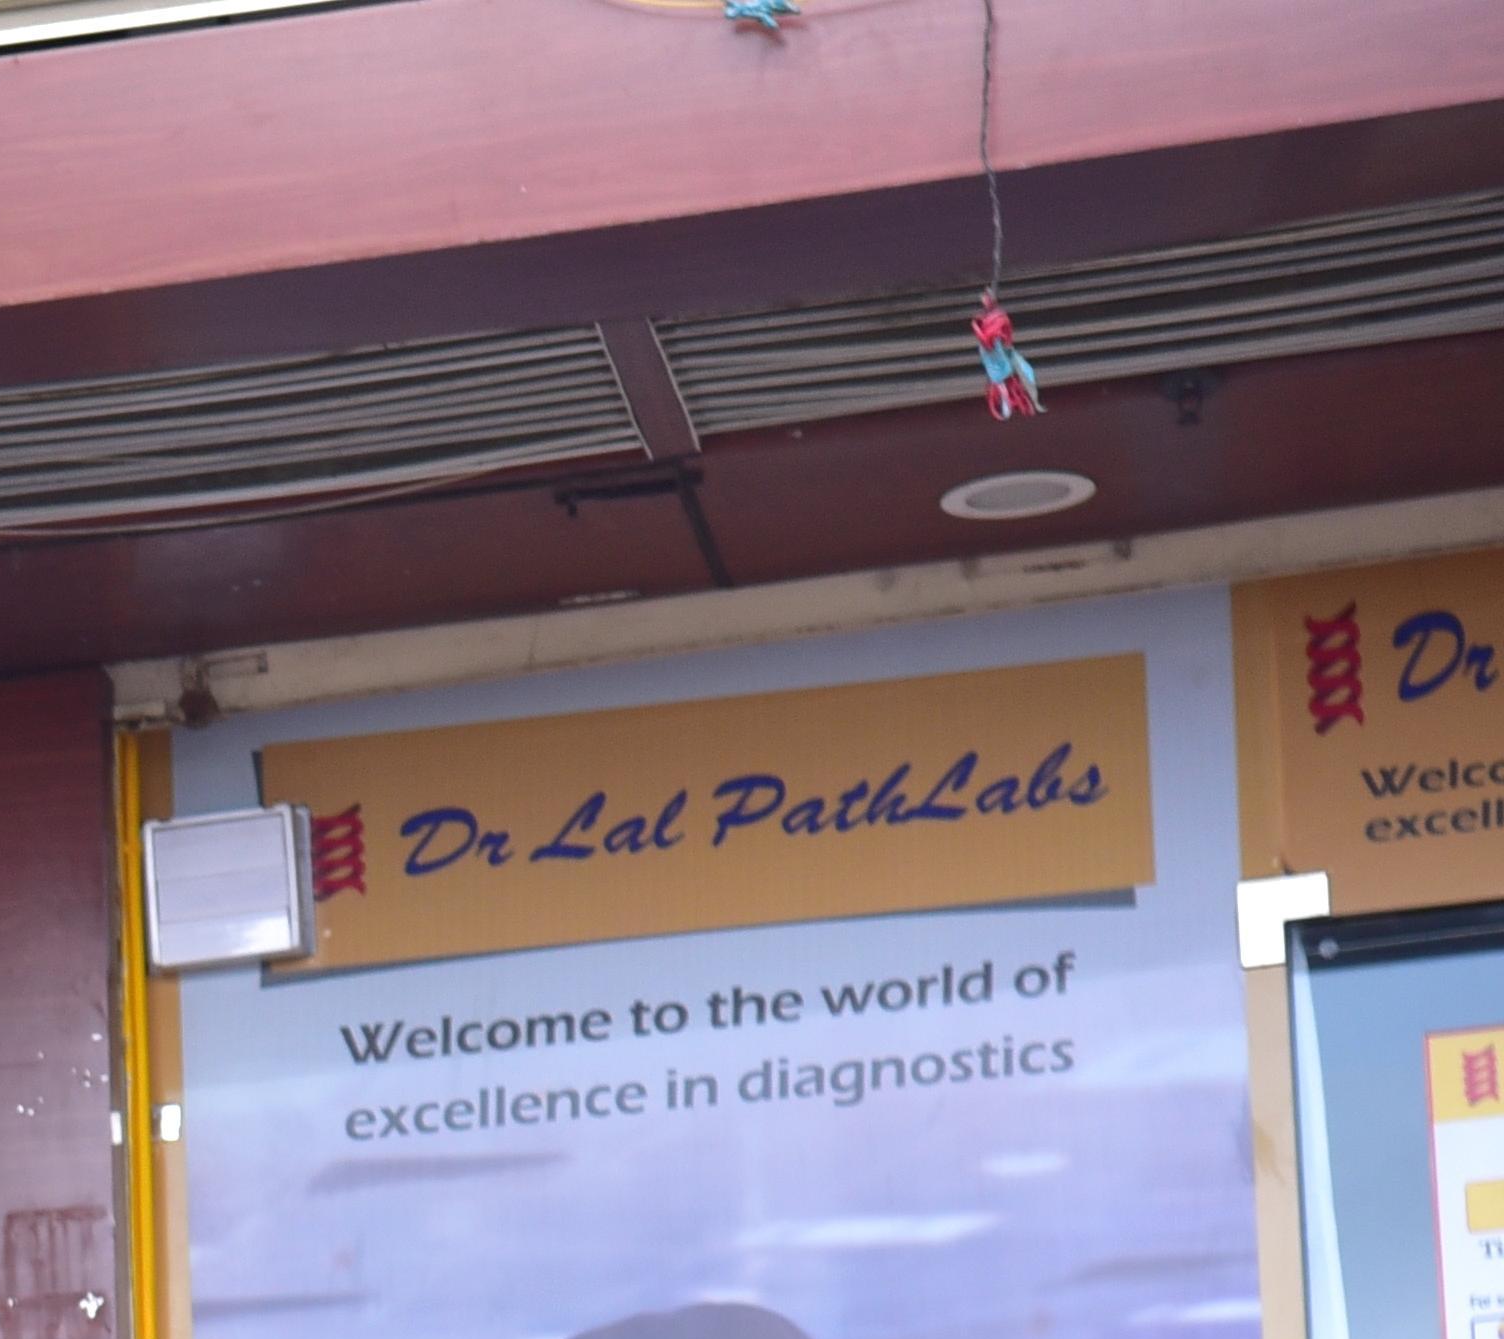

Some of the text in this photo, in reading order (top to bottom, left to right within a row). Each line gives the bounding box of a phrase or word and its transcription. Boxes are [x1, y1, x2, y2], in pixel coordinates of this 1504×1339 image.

[400, 742, 1109, 878] Dr Lal PathLabs
[340, 949, 1076, 1065] Welcome to the world of
[345, 1034, 1074, 1142] excellence in diagnostics
